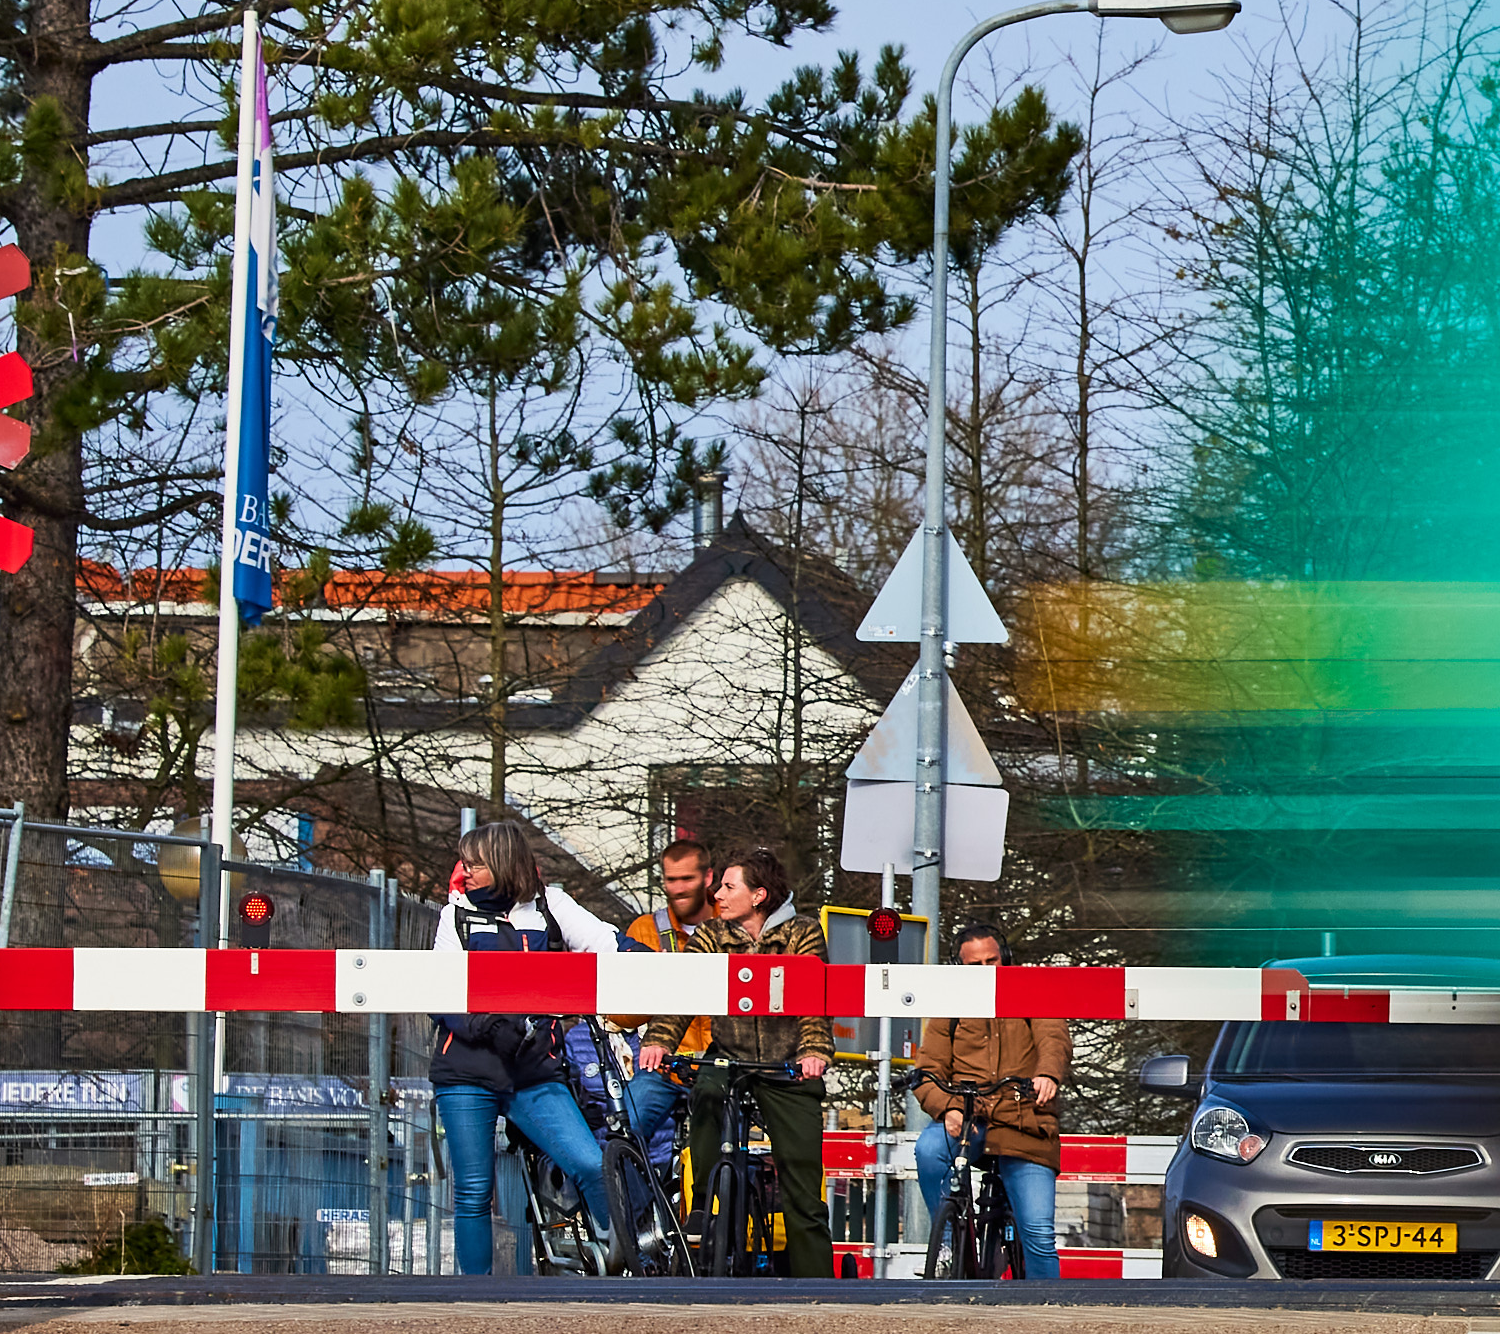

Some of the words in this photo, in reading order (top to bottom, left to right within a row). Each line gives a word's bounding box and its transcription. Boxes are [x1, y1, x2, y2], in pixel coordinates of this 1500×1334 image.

[2, 1082, 75, 1103] IEDERE
[81, 1082, 127, 1103] TUIN
[1373, 1154, 1397, 1165] KIA
[321, 1209, 370, 1222] HERAS
